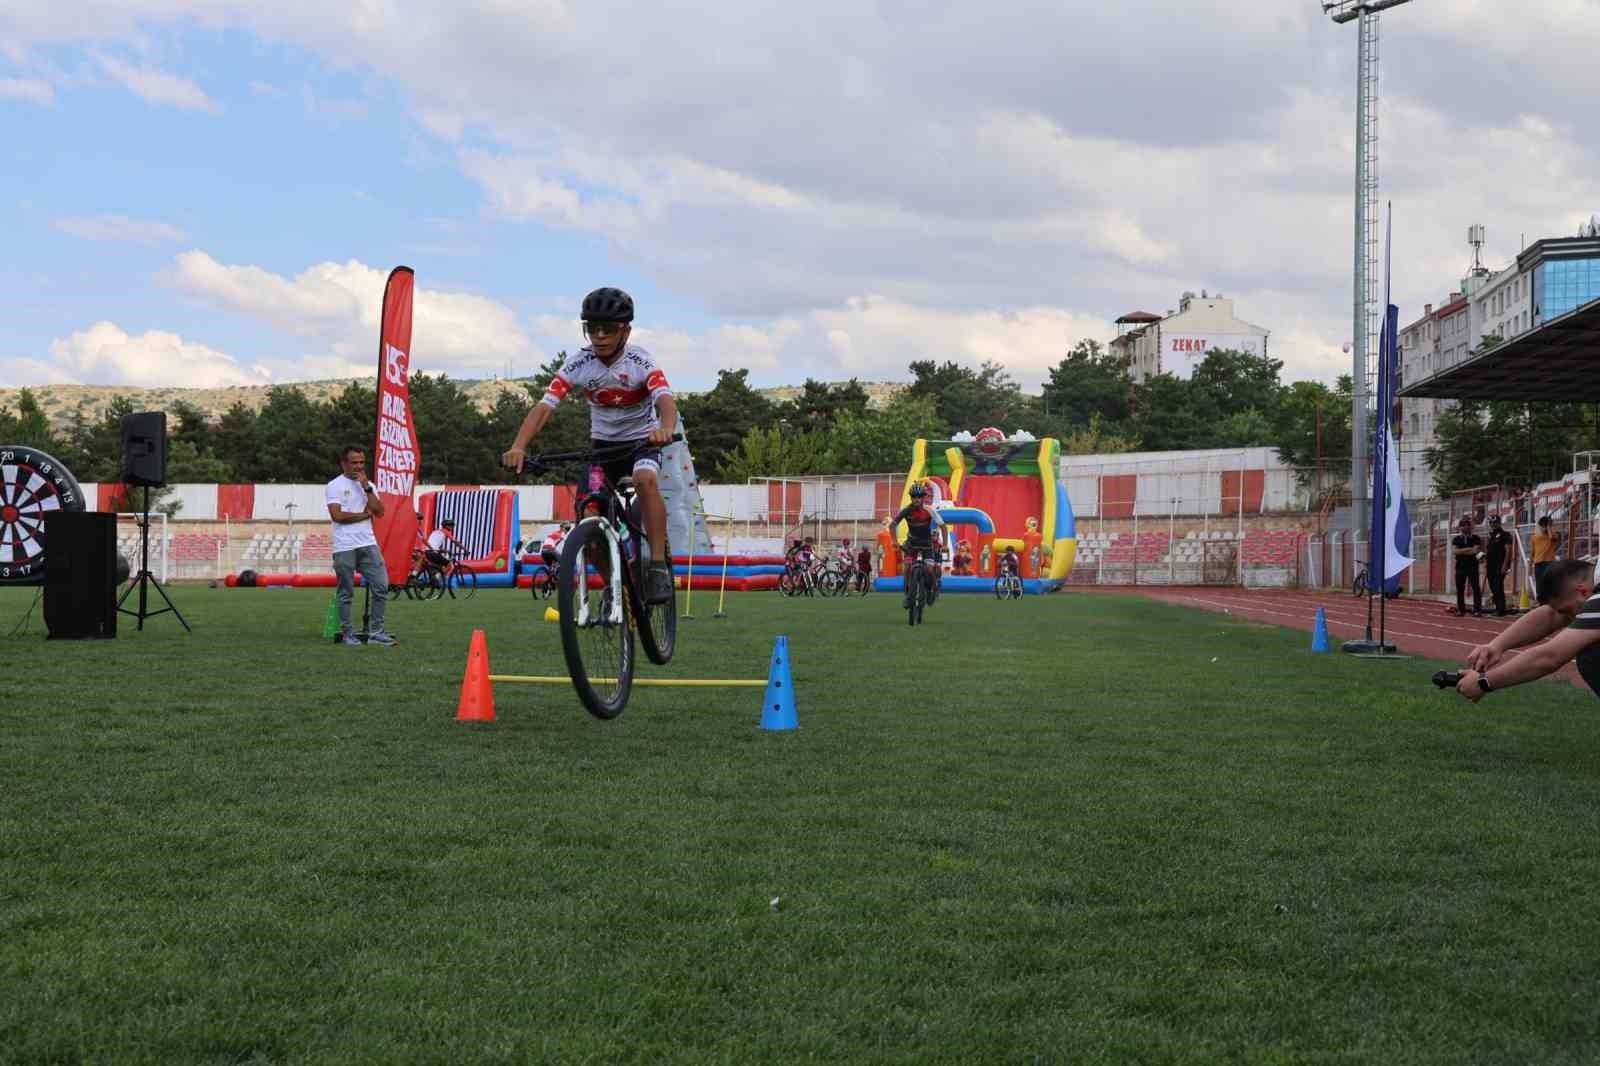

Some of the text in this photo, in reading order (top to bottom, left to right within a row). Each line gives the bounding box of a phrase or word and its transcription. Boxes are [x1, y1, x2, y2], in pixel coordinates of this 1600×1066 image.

[1172, 338, 1206, 351] ZEKAT
[24, 454, 31, 463] 1
[39, 461, 52, 474] 18
[62, 489, 74, 503] 13
[2, 567, 10, 577] 3
